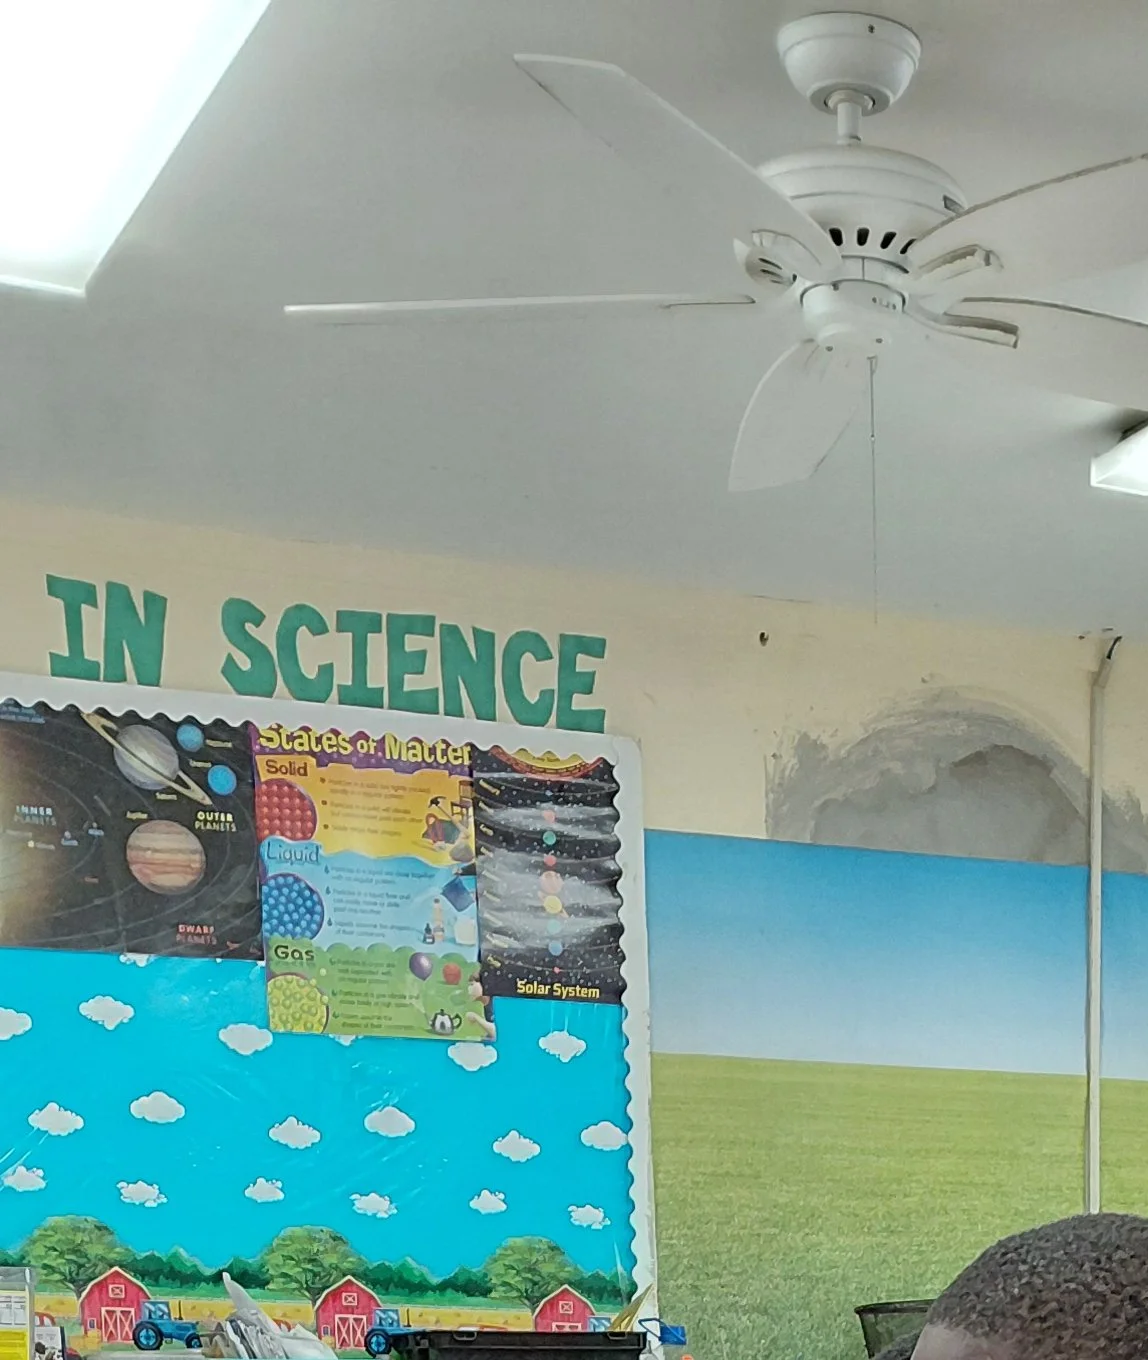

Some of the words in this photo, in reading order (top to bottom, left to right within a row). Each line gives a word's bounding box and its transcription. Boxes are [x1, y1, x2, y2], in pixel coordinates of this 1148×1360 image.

[46, 573, 168, 687] IN
[221, 596, 607, 734] SCIENCE
[259, 723, 354, 756] States
[384, 731, 474, 766] Matter
[265, 758, 310, 778] Solid
[266, 841, 320, 866] Liquid
[274, 944, 315, 962] Gas
[516, 980, 551, 996] Solar
[552, 982, 601, 999] System
